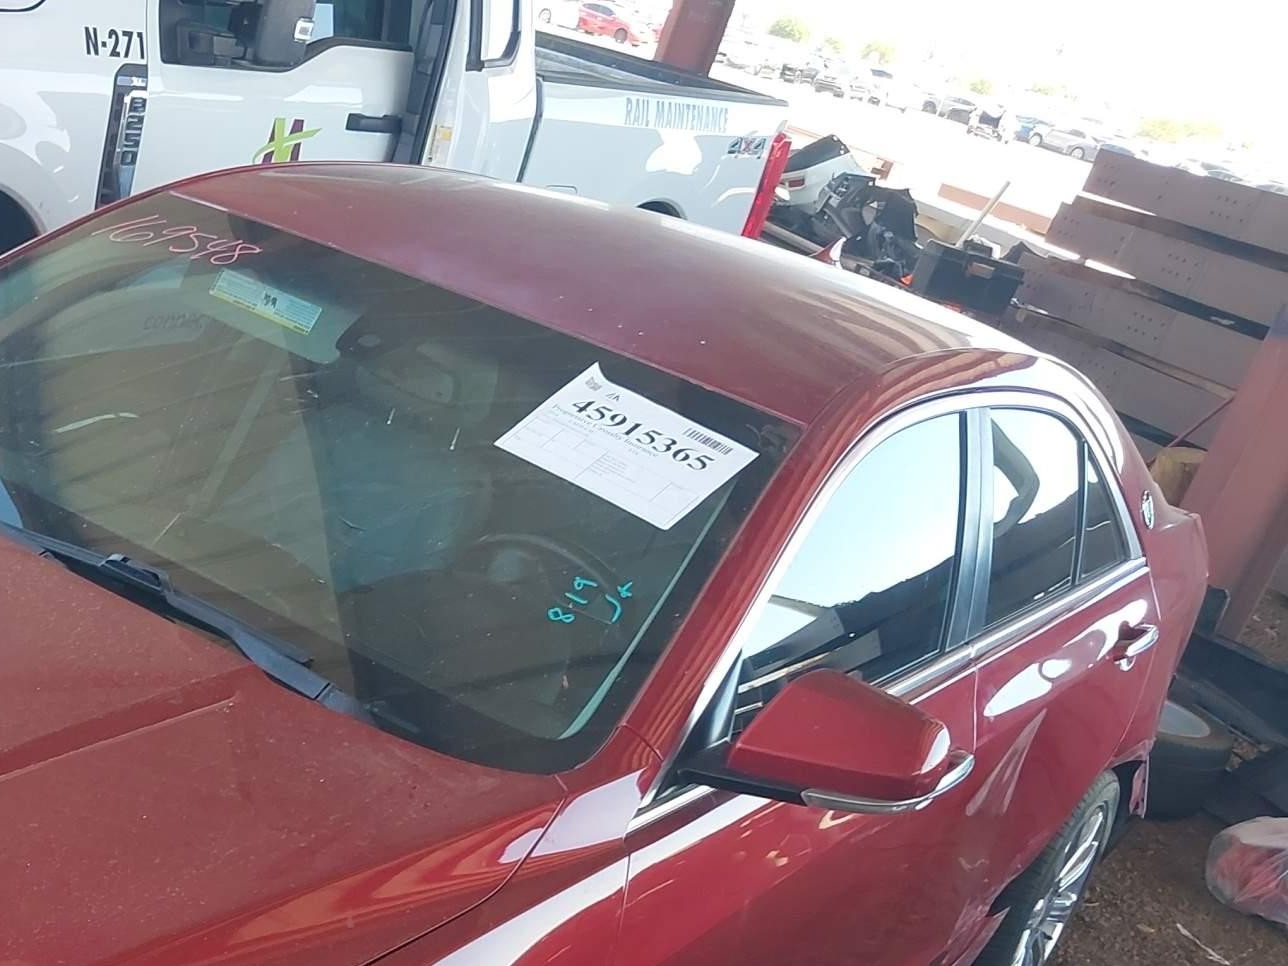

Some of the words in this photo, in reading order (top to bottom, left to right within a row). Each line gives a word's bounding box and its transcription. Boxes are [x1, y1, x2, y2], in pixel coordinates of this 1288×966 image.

[83, 25, 146, 60] N-271
[623, 96, 650, 127] RAIL
[654, 99, 729, 133] MAINTENANCE
[571, 399, 716, 472] 45915365
